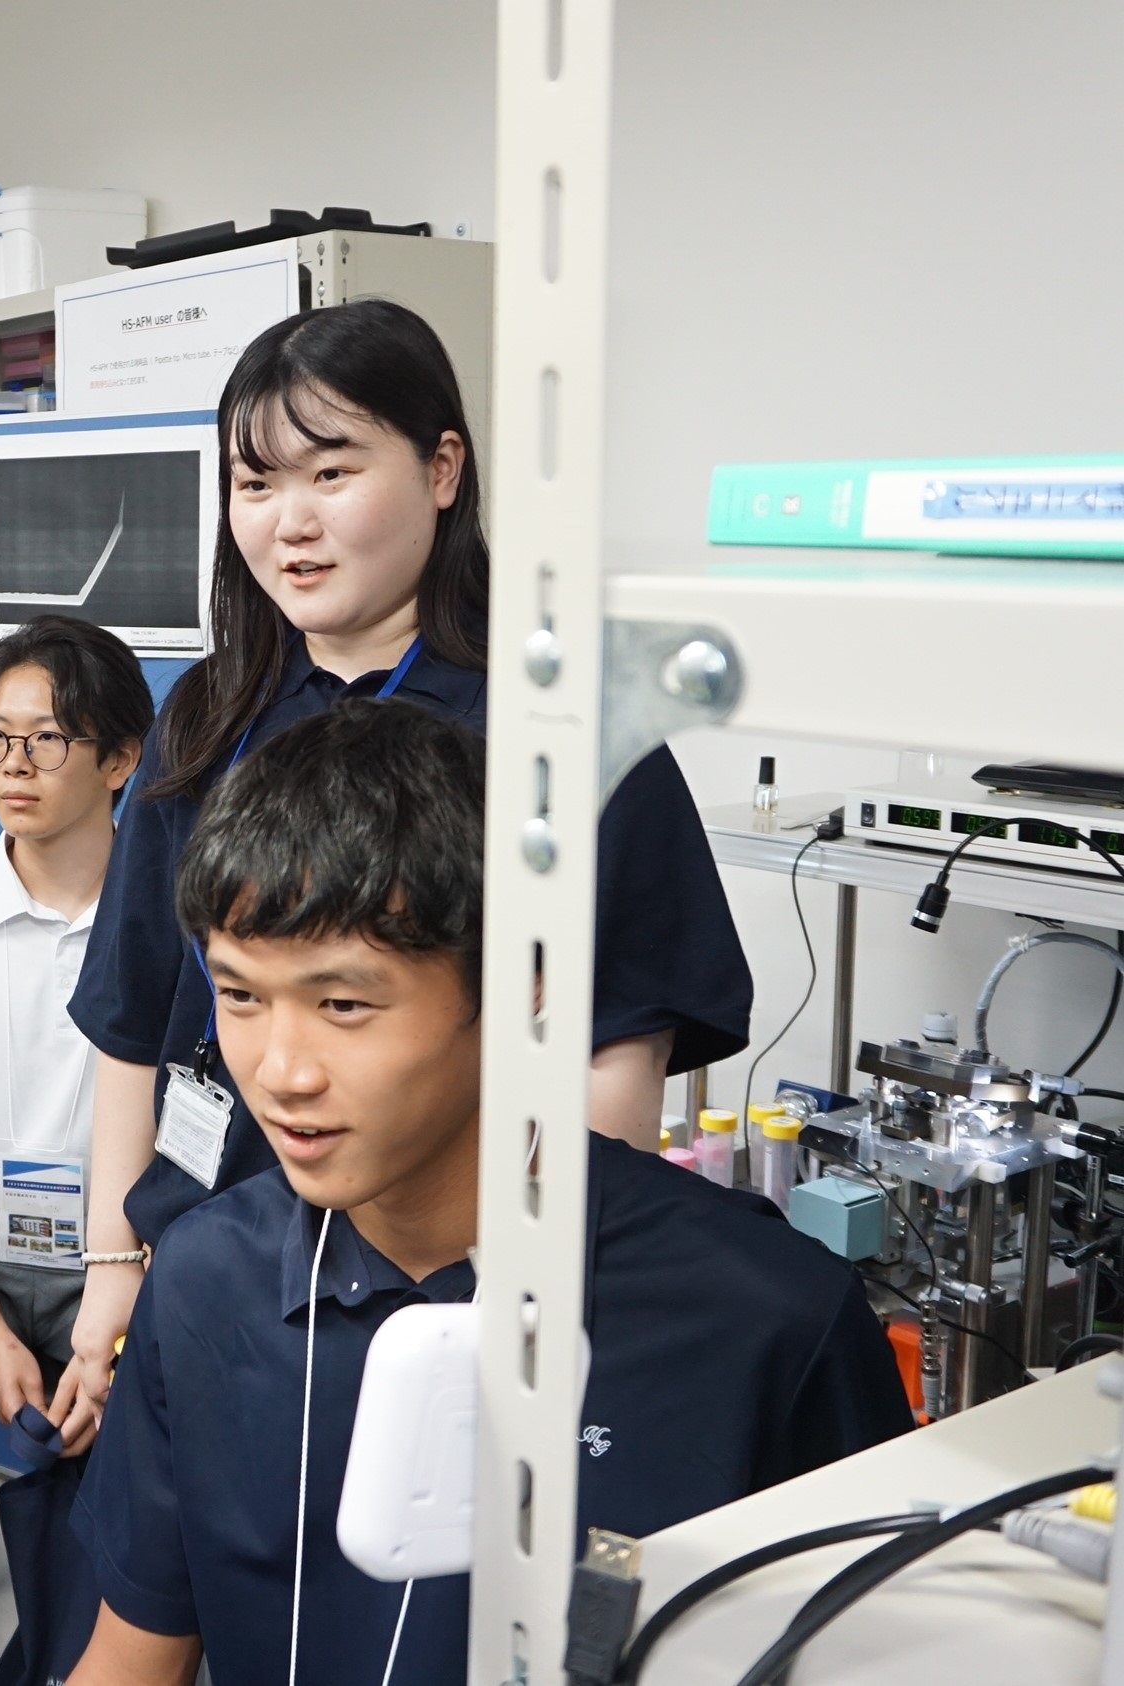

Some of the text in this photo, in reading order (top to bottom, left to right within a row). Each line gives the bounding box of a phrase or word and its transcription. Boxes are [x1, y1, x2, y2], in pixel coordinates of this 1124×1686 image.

[121, 306, 208, 331] HS-AFM user の皆様へ
